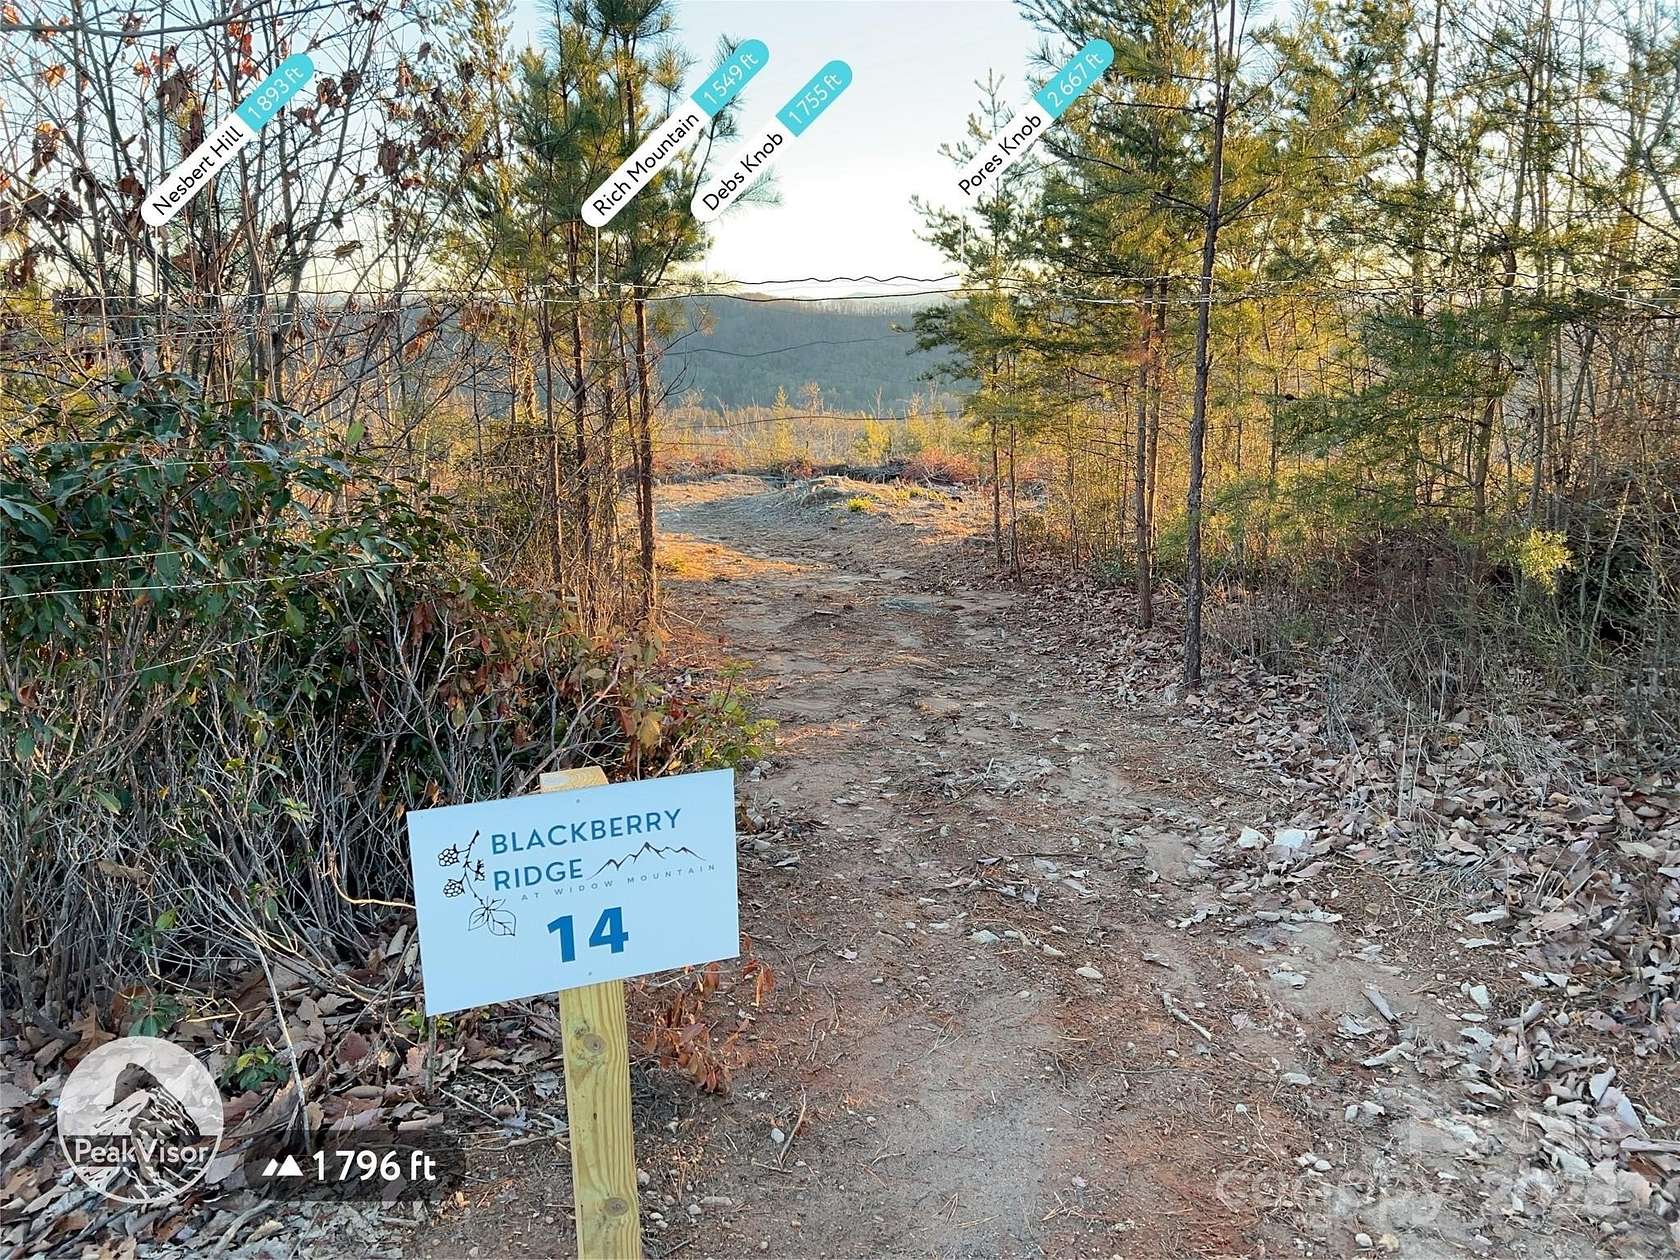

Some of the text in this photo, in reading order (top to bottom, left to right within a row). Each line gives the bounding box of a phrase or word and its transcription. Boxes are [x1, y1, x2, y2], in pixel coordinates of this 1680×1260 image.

[491, 808, 682, 855] BLACKBERRY
[493, 858, 583, 891] RIDGE
[521, 864, 716, 901] AT WIDOW MOUNTAIN
[547, 906, 629, 963] 14
